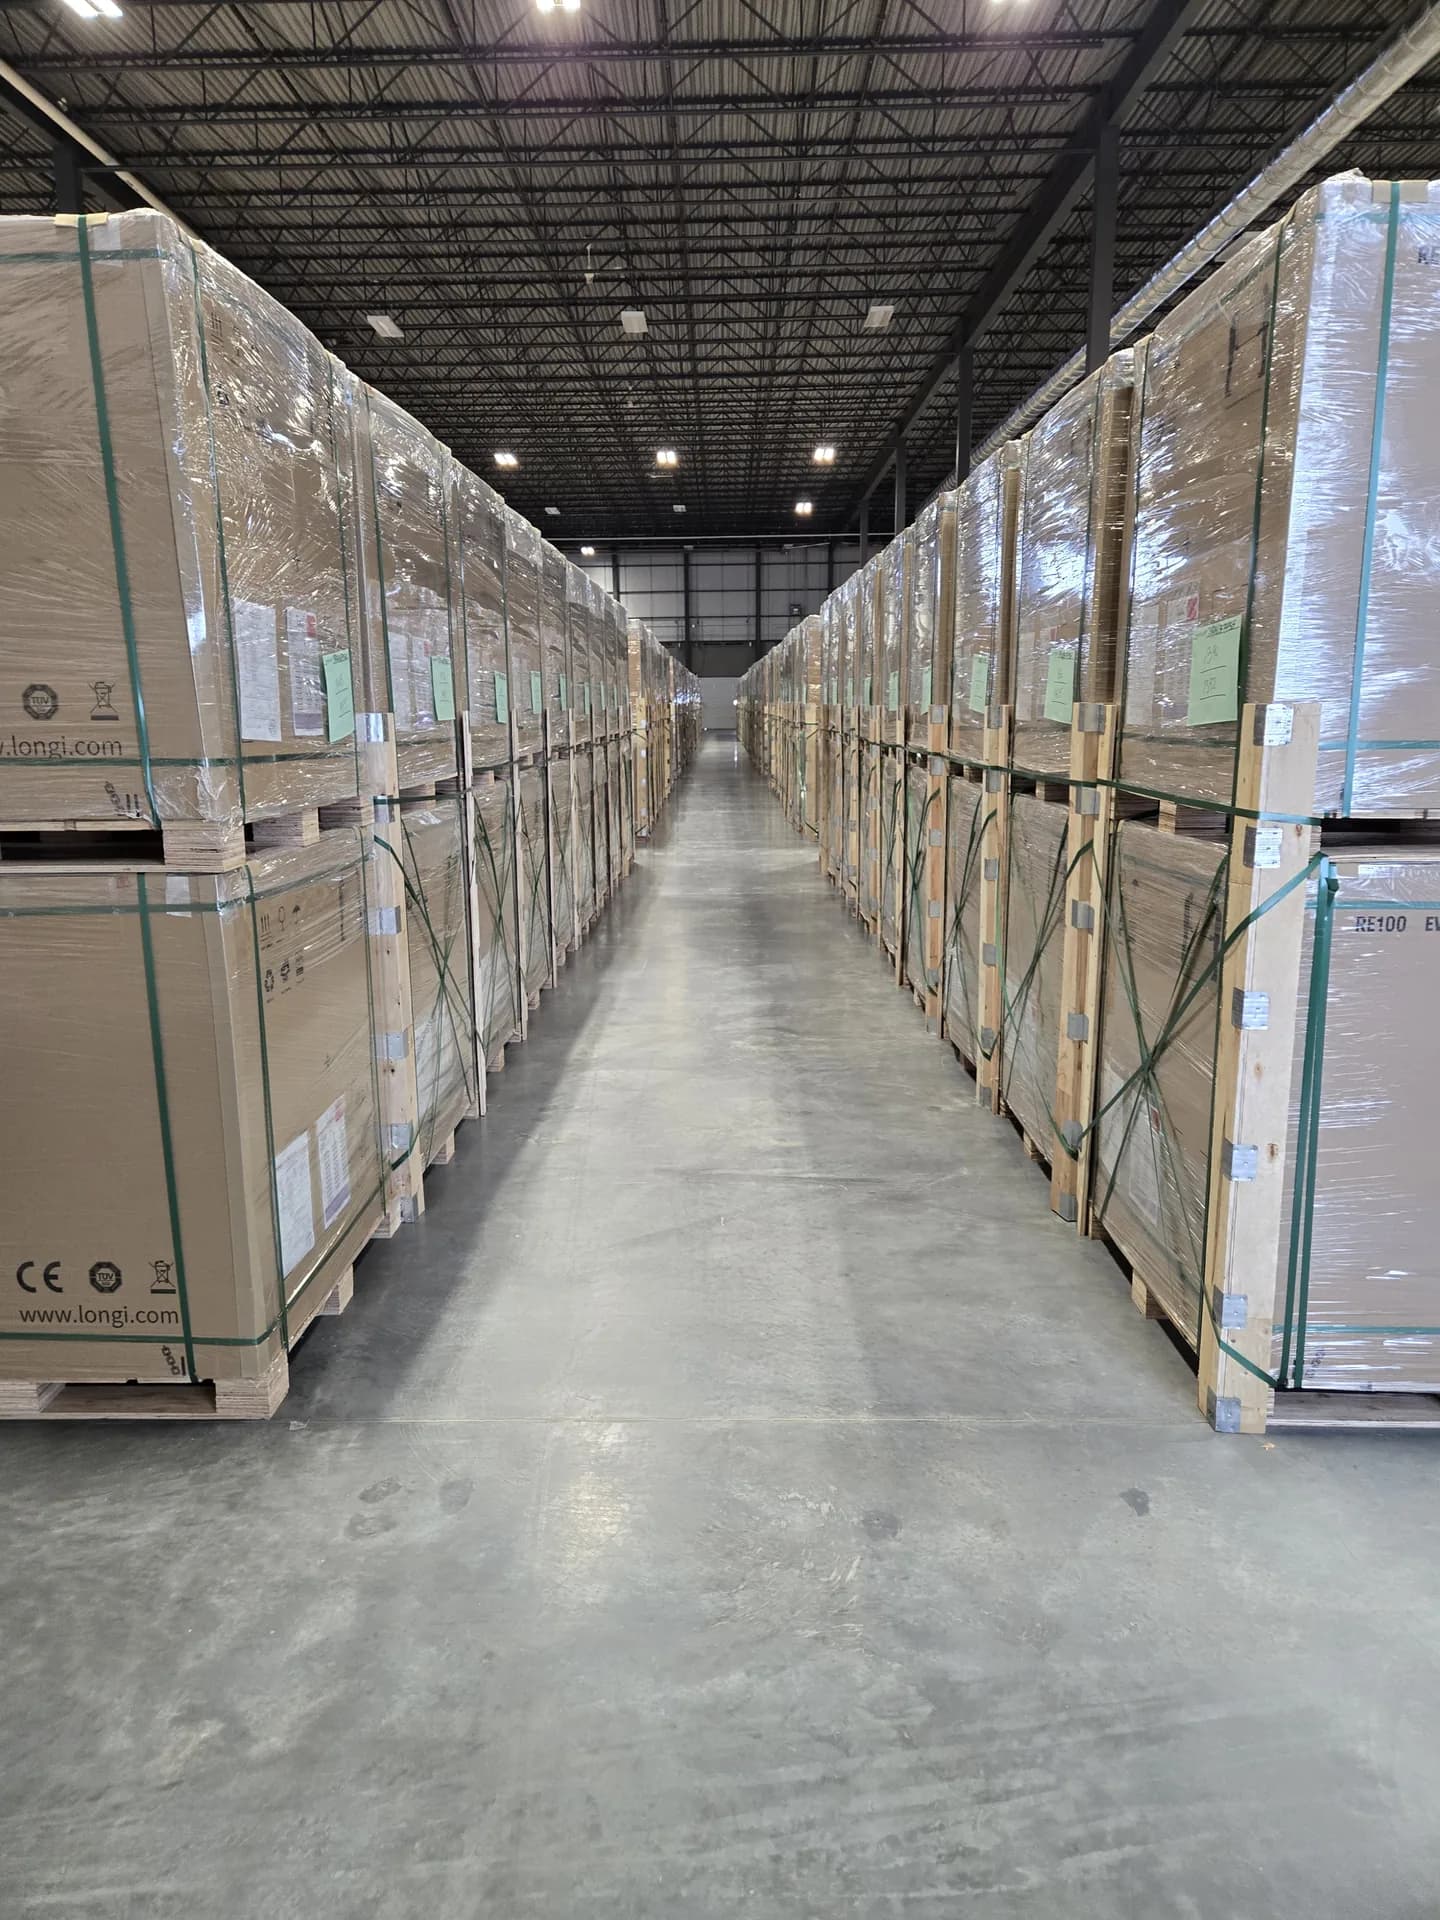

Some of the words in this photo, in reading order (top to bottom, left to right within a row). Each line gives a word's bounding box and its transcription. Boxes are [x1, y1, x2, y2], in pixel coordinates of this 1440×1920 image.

[0, 735, 123, 760] .longi.com
[1355, 916, 1407, 932] RE100
[16, 1261, 64, 1293] CE
[19, 1305, 179, 1328] www.longi.com
